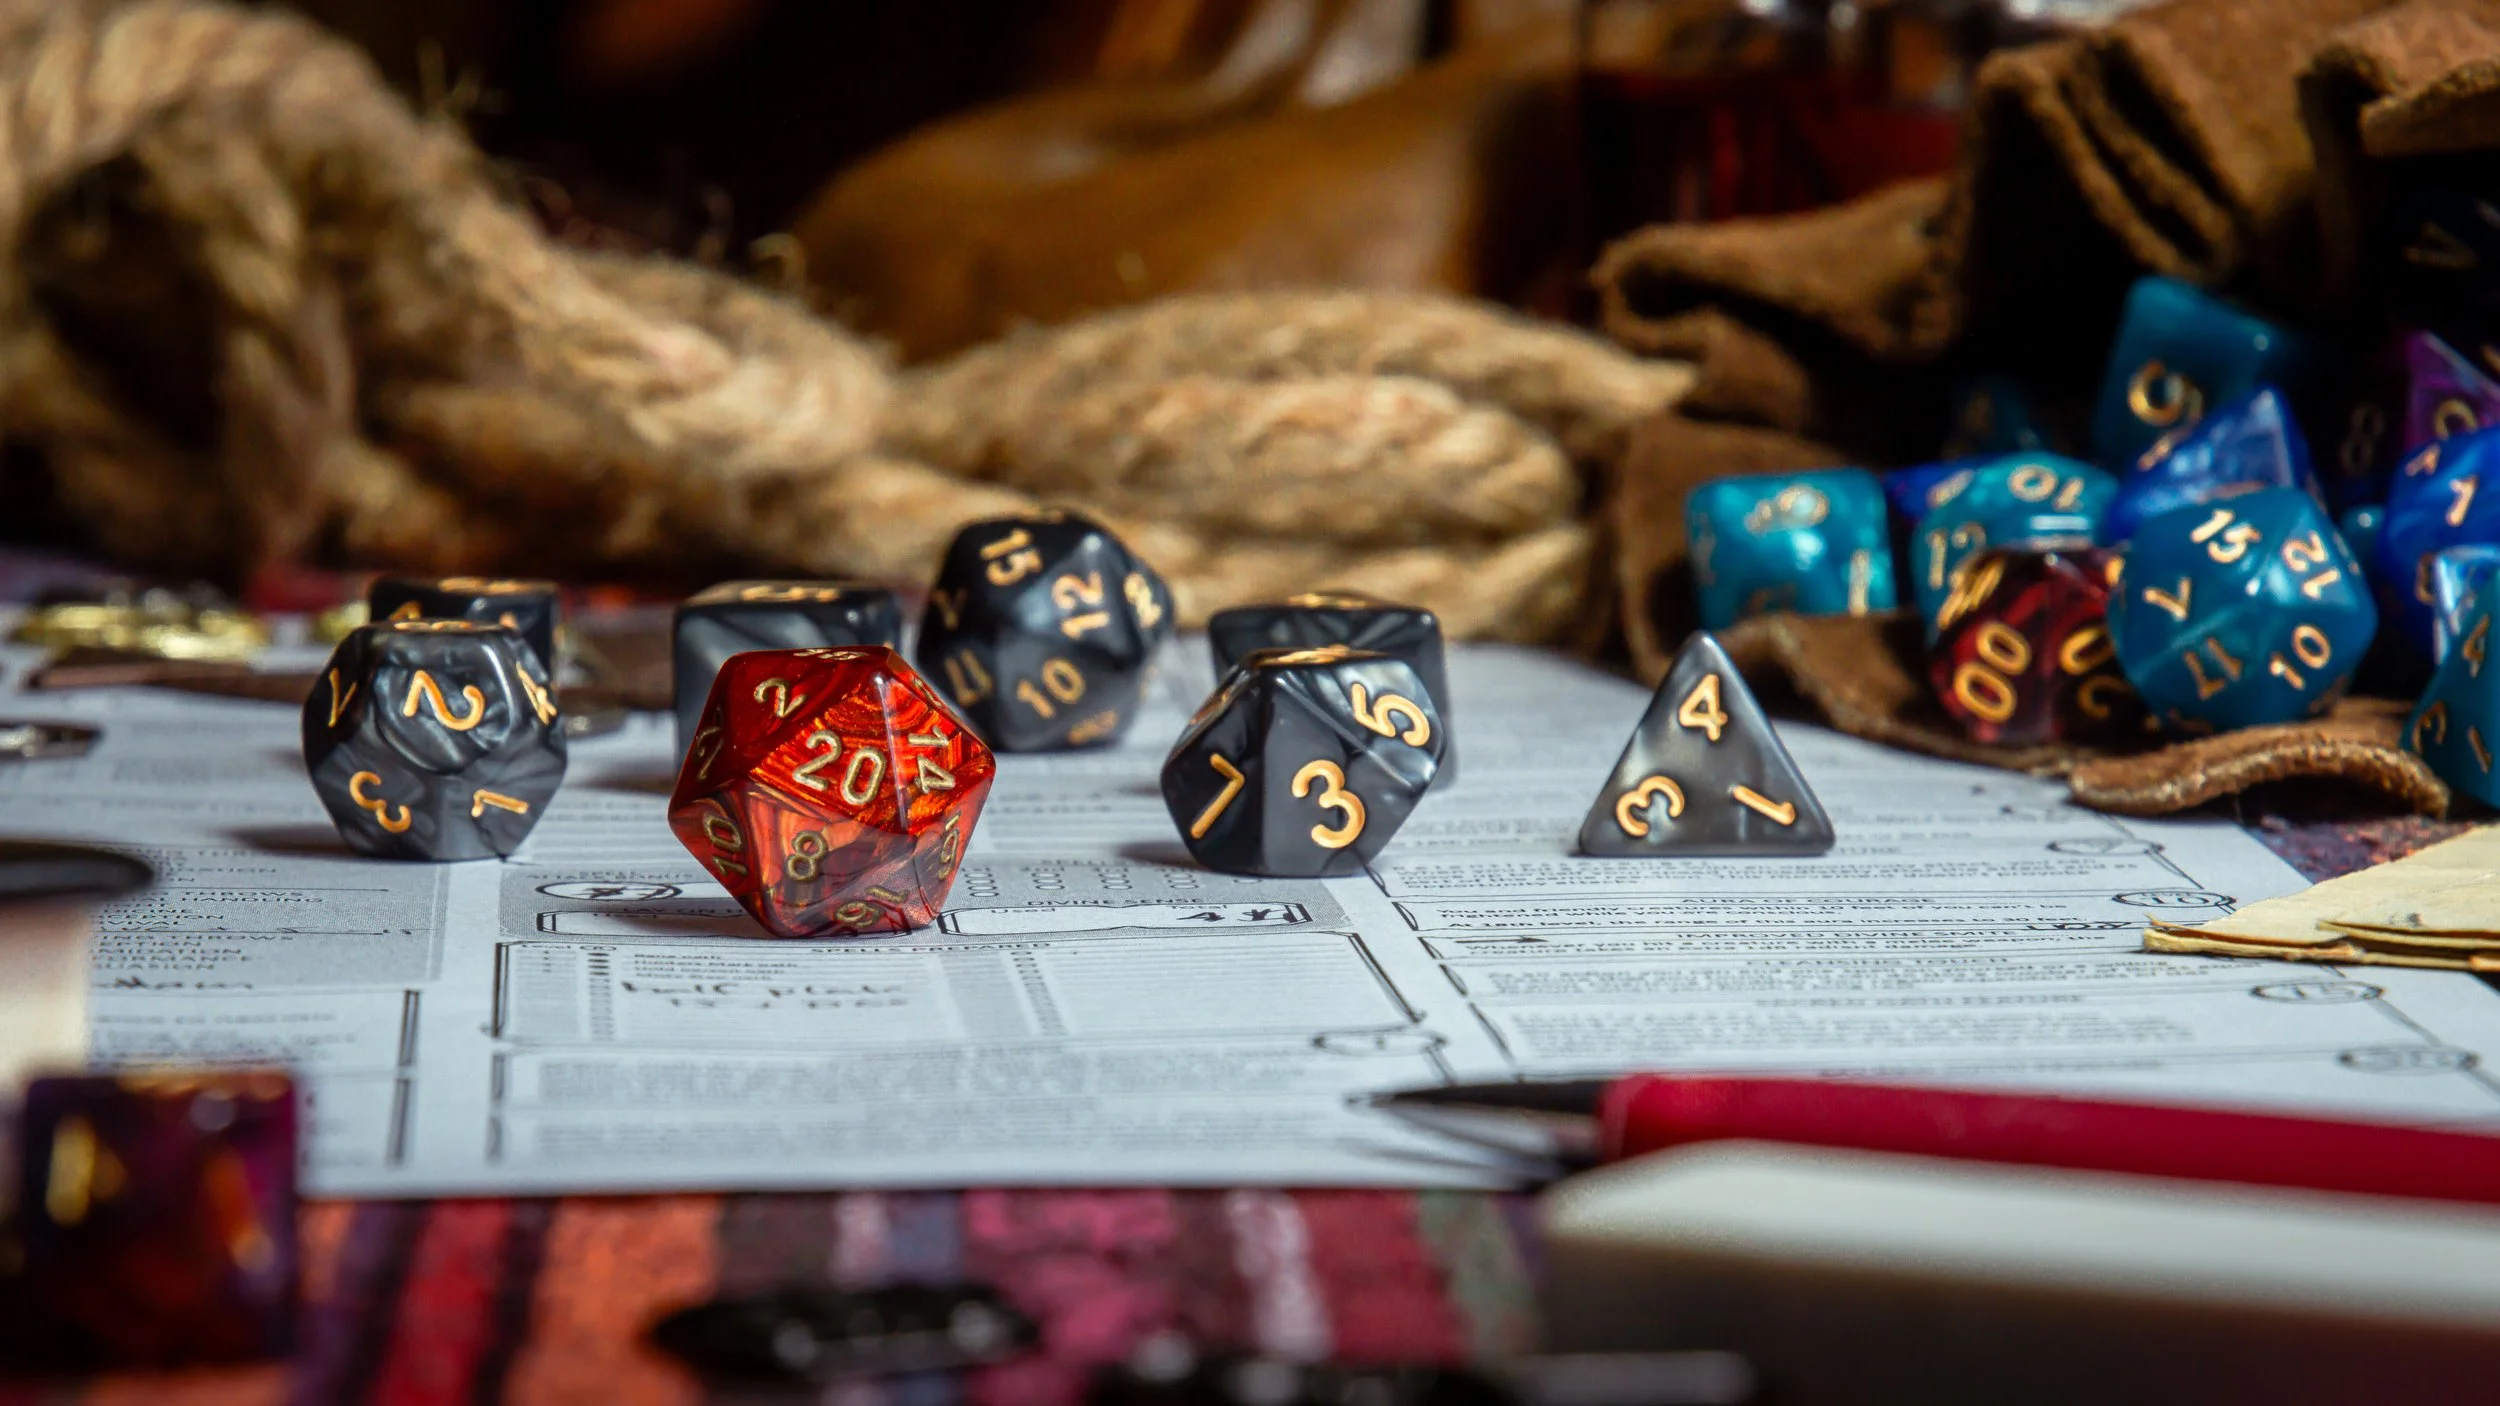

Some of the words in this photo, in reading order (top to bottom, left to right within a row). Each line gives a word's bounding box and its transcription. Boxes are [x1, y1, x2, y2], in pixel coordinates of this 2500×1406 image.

[980, 527, 1043, 586] 15
[2190, 507, 2262, 565] 15
[1015, 656, 1087, 720] 10
[2269, 624, 2332, 690] 10
[402, 668, 487, 732] 2
[514, 660, 559, 727] 4
[753, 676, 808, 720] 2
[1351, 682, 1431, 748] 5
[1677, 672, 1729, 742] 4
[792, 729, 888, 806] 20
[906, 725, 956, 795] 14
[348, 769, 412, 834] 3
[1190, 752, 1246, 840] 7
[1291, 758, 1367, 849] 3
[1614, 774, 1686, 838] 3
[1728, 784, 1797, 827] 1
[702, 811, 750, 878] 10
[786, 830, 828, 884] 8
